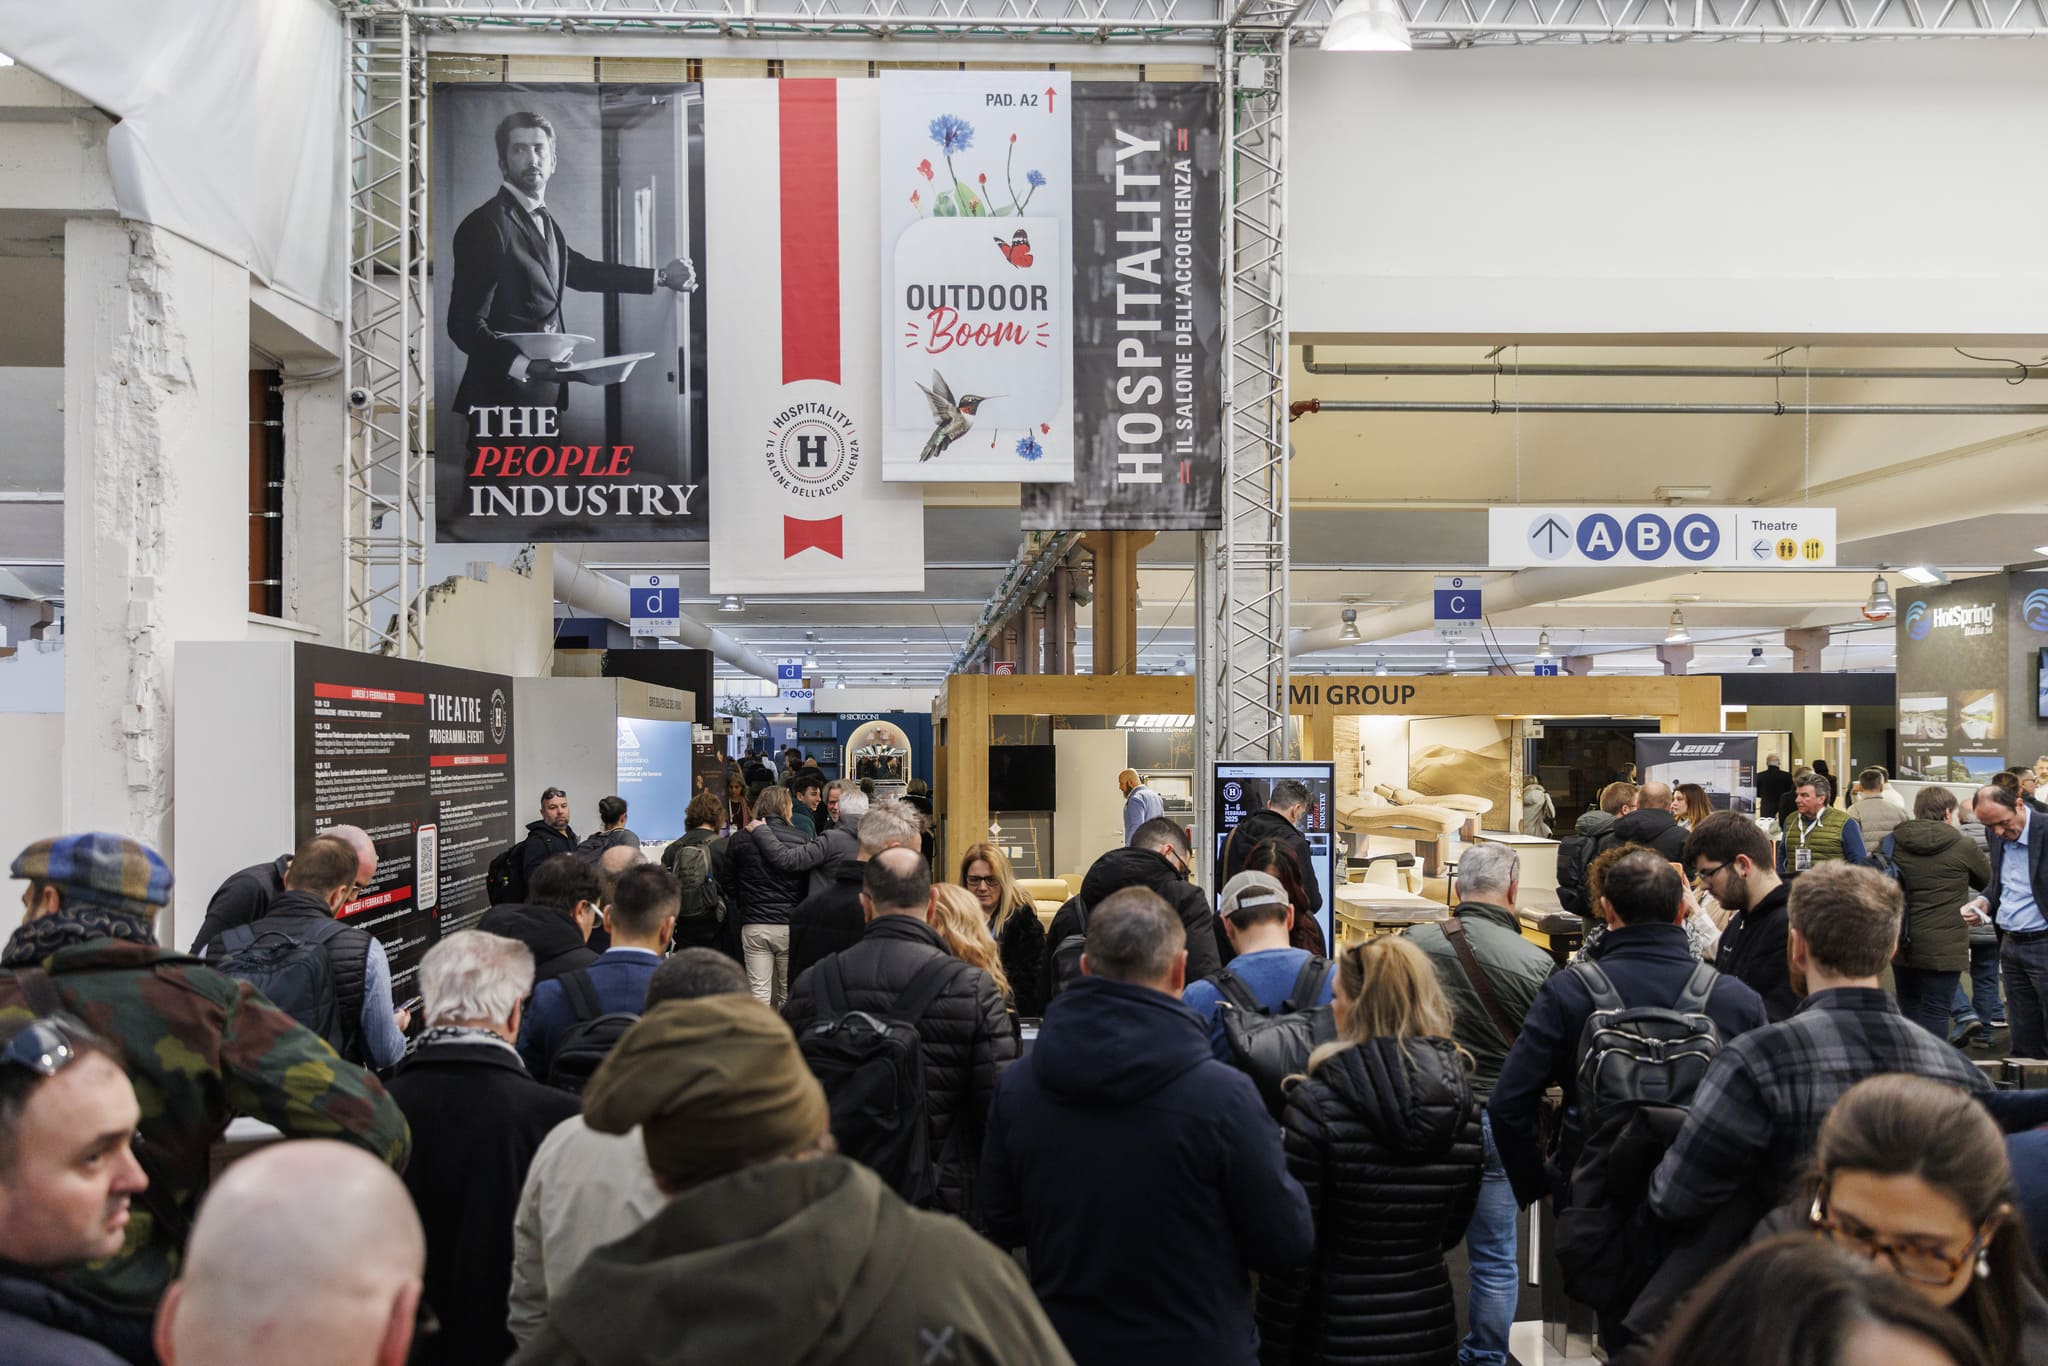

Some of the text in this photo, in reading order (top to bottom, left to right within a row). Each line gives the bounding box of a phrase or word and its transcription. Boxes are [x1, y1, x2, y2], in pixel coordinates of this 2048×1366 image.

[985, 93, 1038, 107] PAD. A2
[906, 284, 1048, 311] OUTDOOR
[1115, 128, 1164, 484] HOSPITALITY
[1174, 159, 1193, 453] IL SALONE DELL'ACCOGLIENZA
[925, 306, 1030, 354] Boom
[468, 405, 560, 437] THE
[773, 402, 853, 429] HOSPITALITY
[469, 445, 635, 477] PEOPLE
[797, 435, 828, 468] H
[766, 451, 791, 490] SALONE
[469, 483, 699, 516] INDUSTRY
[1586, 521, 1711, 553] A B C
[1751, 520, 1798, 532] Theatre
[646, 589, 663, 614] d
[785, 665, 795, 678] d
[428, 693, 482, 723] THEATRE
[1326, 684, 1415, 705] GROUP
[429, 729, 485, 744] PROGRAMMA EVENTI
[1669, 740, 1726, 754] Lemi
[1229, 788, 1236, 796] H
[1306, 813, 1314, 829] THE
